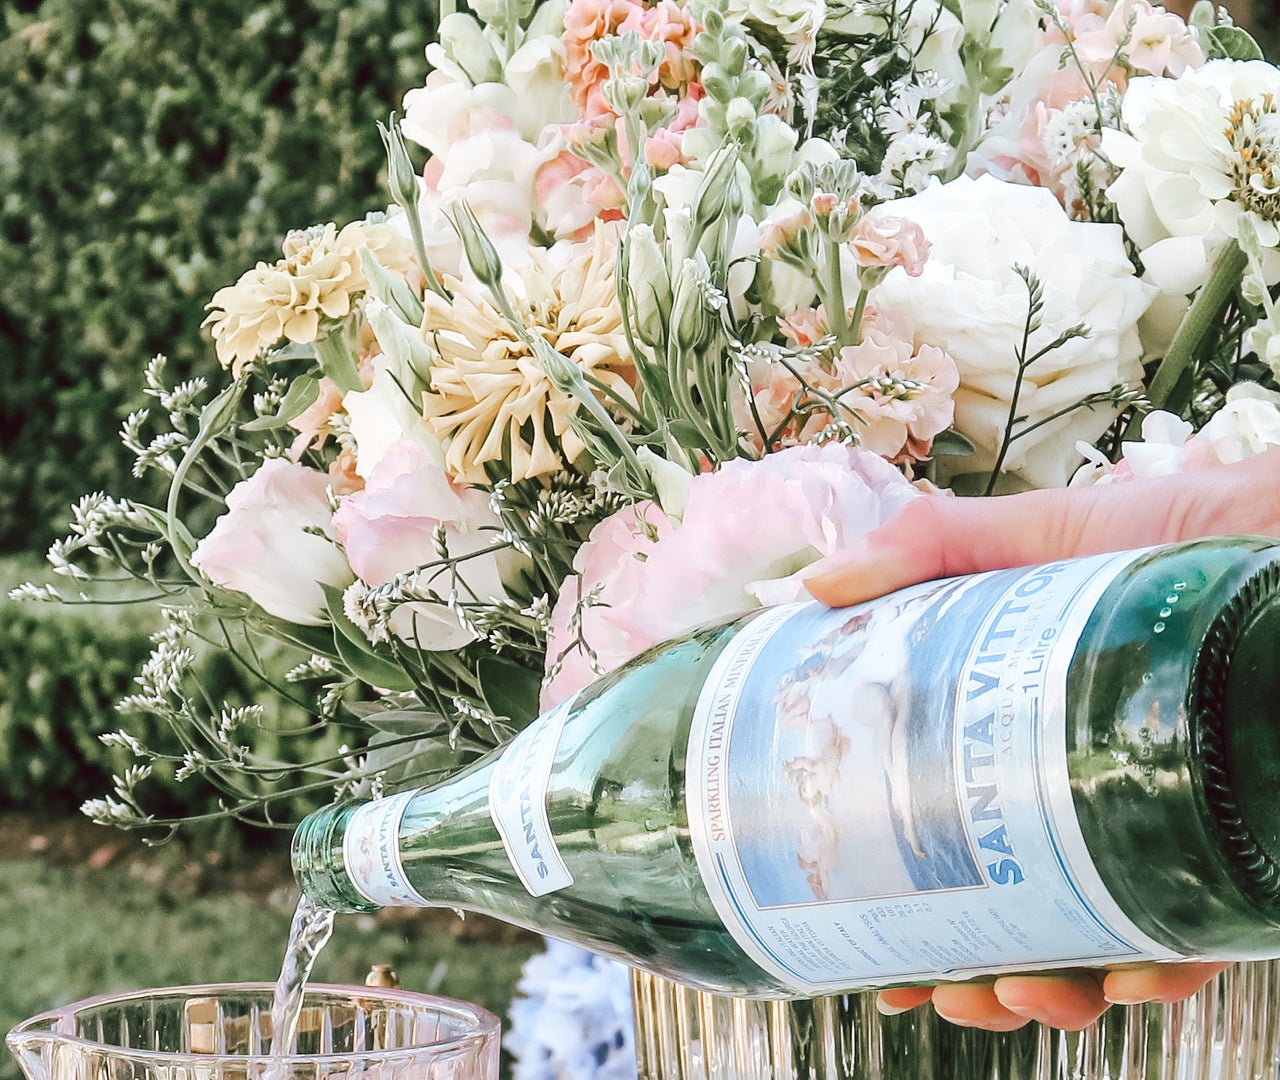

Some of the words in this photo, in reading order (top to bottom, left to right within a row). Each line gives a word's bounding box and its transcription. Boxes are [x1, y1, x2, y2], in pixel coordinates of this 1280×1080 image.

[724, 636, 762, 690] MINERAL
[1027, 626, 1057, 680] Litre
[1023, 683, 1038, 694] 1
[709, 694, 731, 752] ITALIAN
[999, 683, 1015, 757] ACQUA
[707, 754, 725, 842] SPARKLING
[963, 711, 1025, 886] SANTA
[520, 789, 549, 880] SANTA
[380, 844, 399, 887] SANTA
